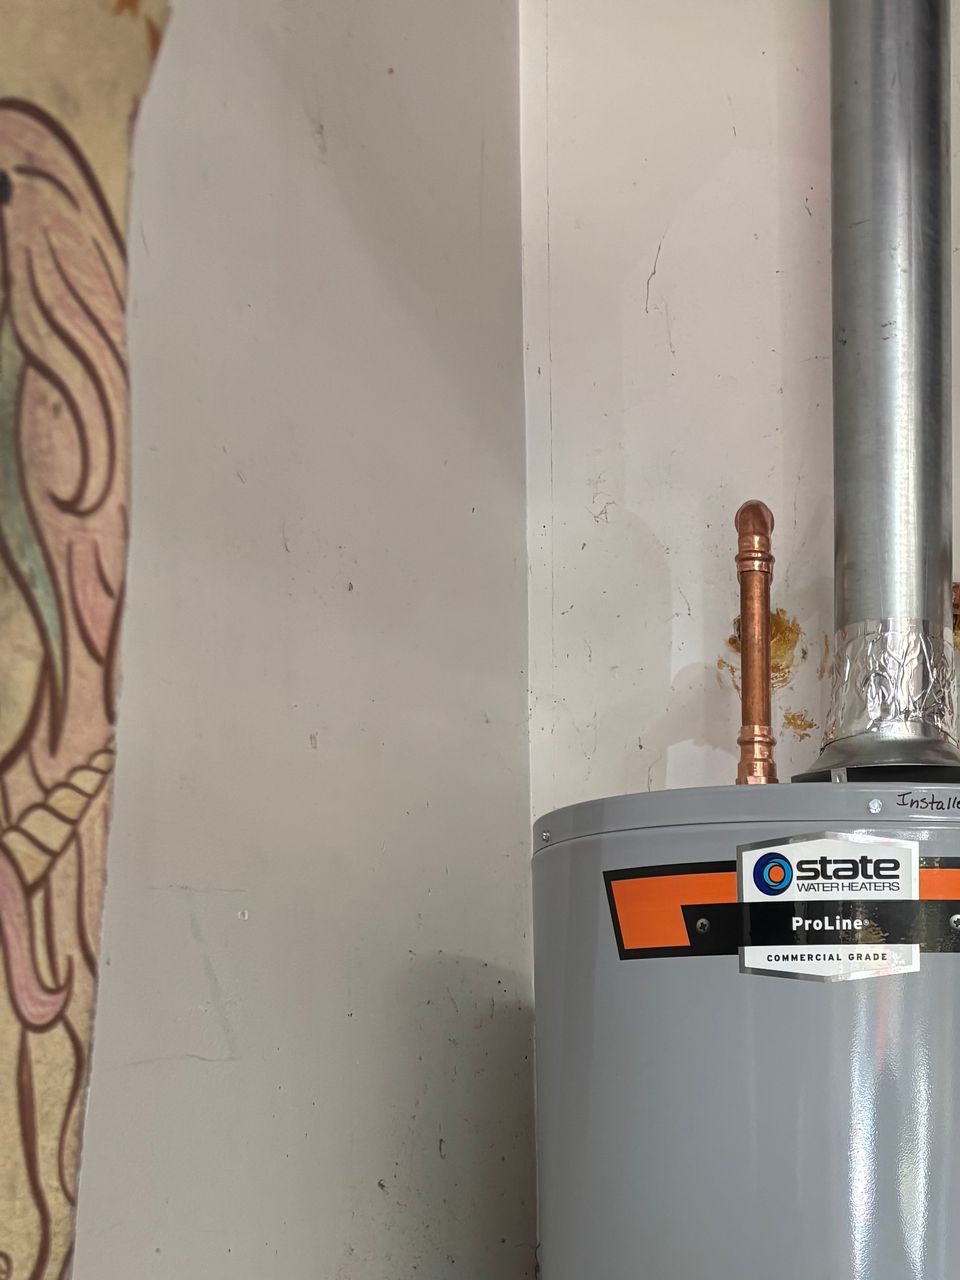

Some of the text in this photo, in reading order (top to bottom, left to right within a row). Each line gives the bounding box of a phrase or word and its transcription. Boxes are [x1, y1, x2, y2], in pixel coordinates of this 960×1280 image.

[796, 856, 900, 881] state
[797, 882, 900, 892] WATER HEATERS
[767, 953, 888, 963] COMMERCIAL GRADE
